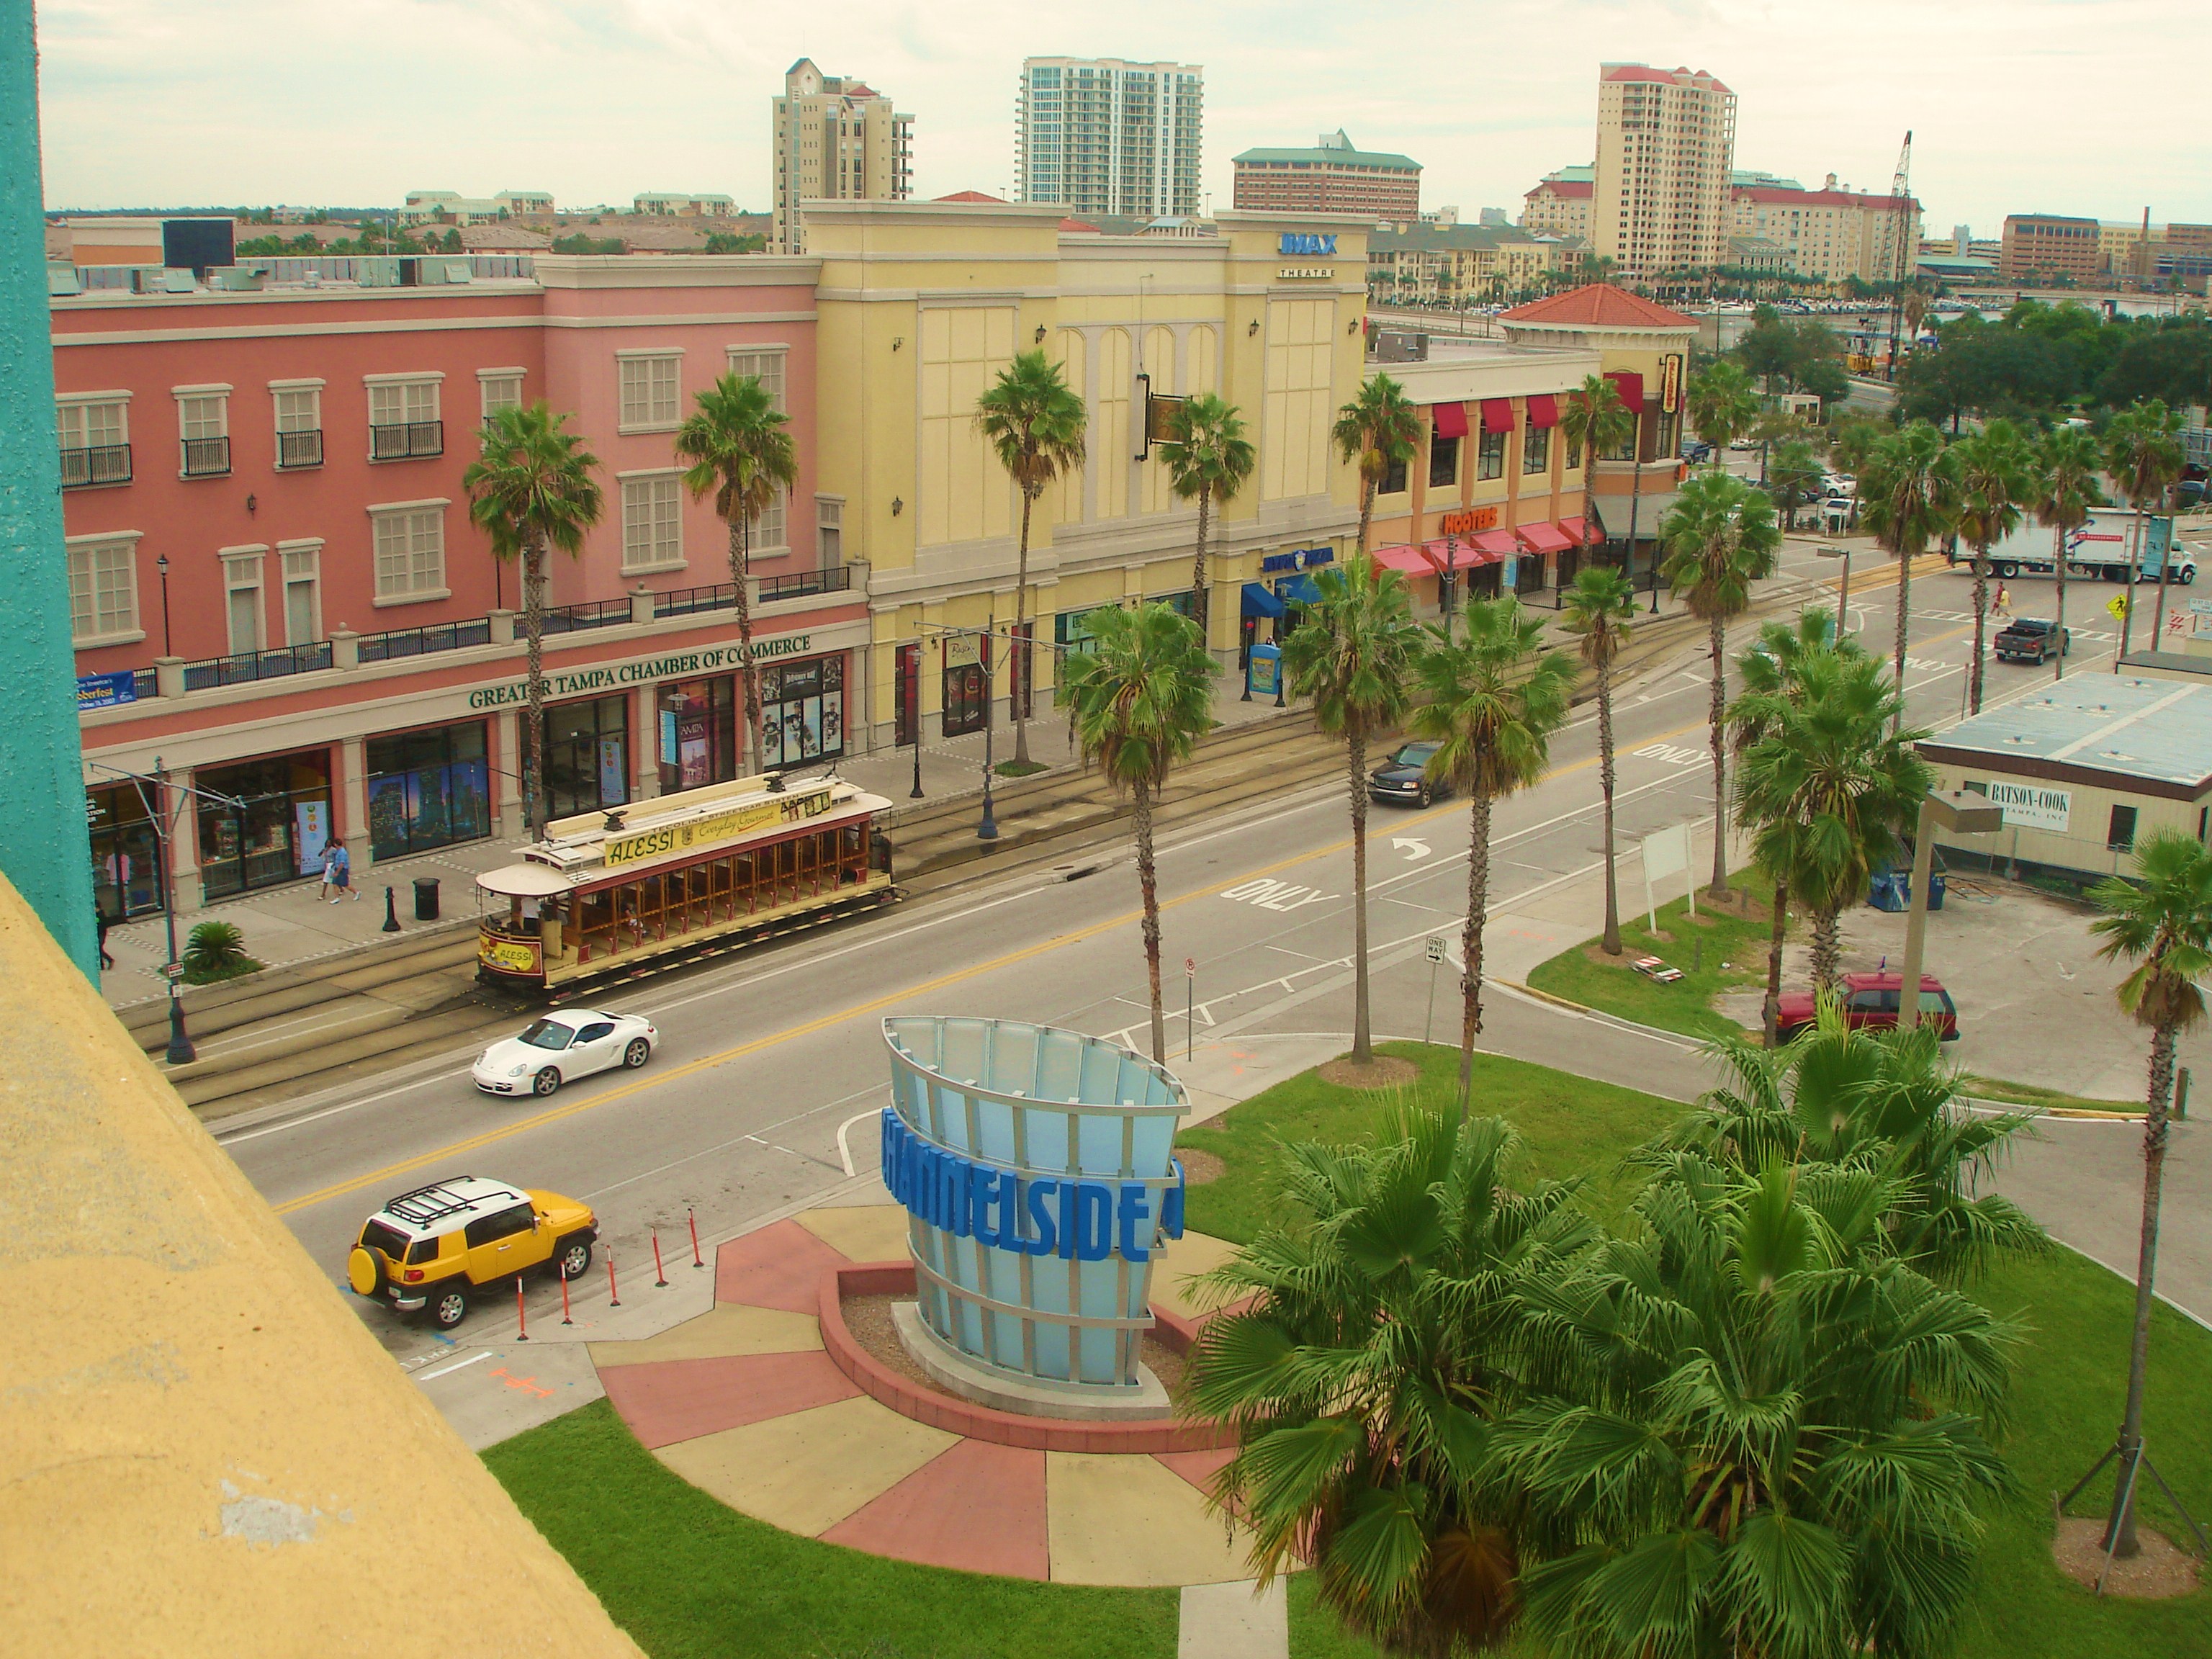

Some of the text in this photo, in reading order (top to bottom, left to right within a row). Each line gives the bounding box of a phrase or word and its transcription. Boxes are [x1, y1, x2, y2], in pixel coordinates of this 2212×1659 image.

[1278, 233, 1338, 255] IMAX
[1443, 506, 1498, 534] HOOTERS
[1888, 657, 1960, 672] ONLY
[469, 679, 552, 709] GREATR
[556, 669, 616, 694] TAMPA
[619, 654, 699, 682] CHAMBER
[703, 650, 724, 668] OF
[77, 688, 114, 701] oberfest
[1632, 743, 1713, 765] ONLY
[708, 803, 762, 820] STREETCAR
[764, 793, 800, 806] SYSTEM
[1991, 783, 2068, 812] BATSON-COOK
[610, 811, 775, 863] ALESSI Everyday Gourmet
[1220, 878, 1341, 912] ONLY
[500, 950, 532, 961] ALESSI
[1429, 938, 1443, 948] ONE
[881, 1107, 1150, 1263] HANNELSIDE
